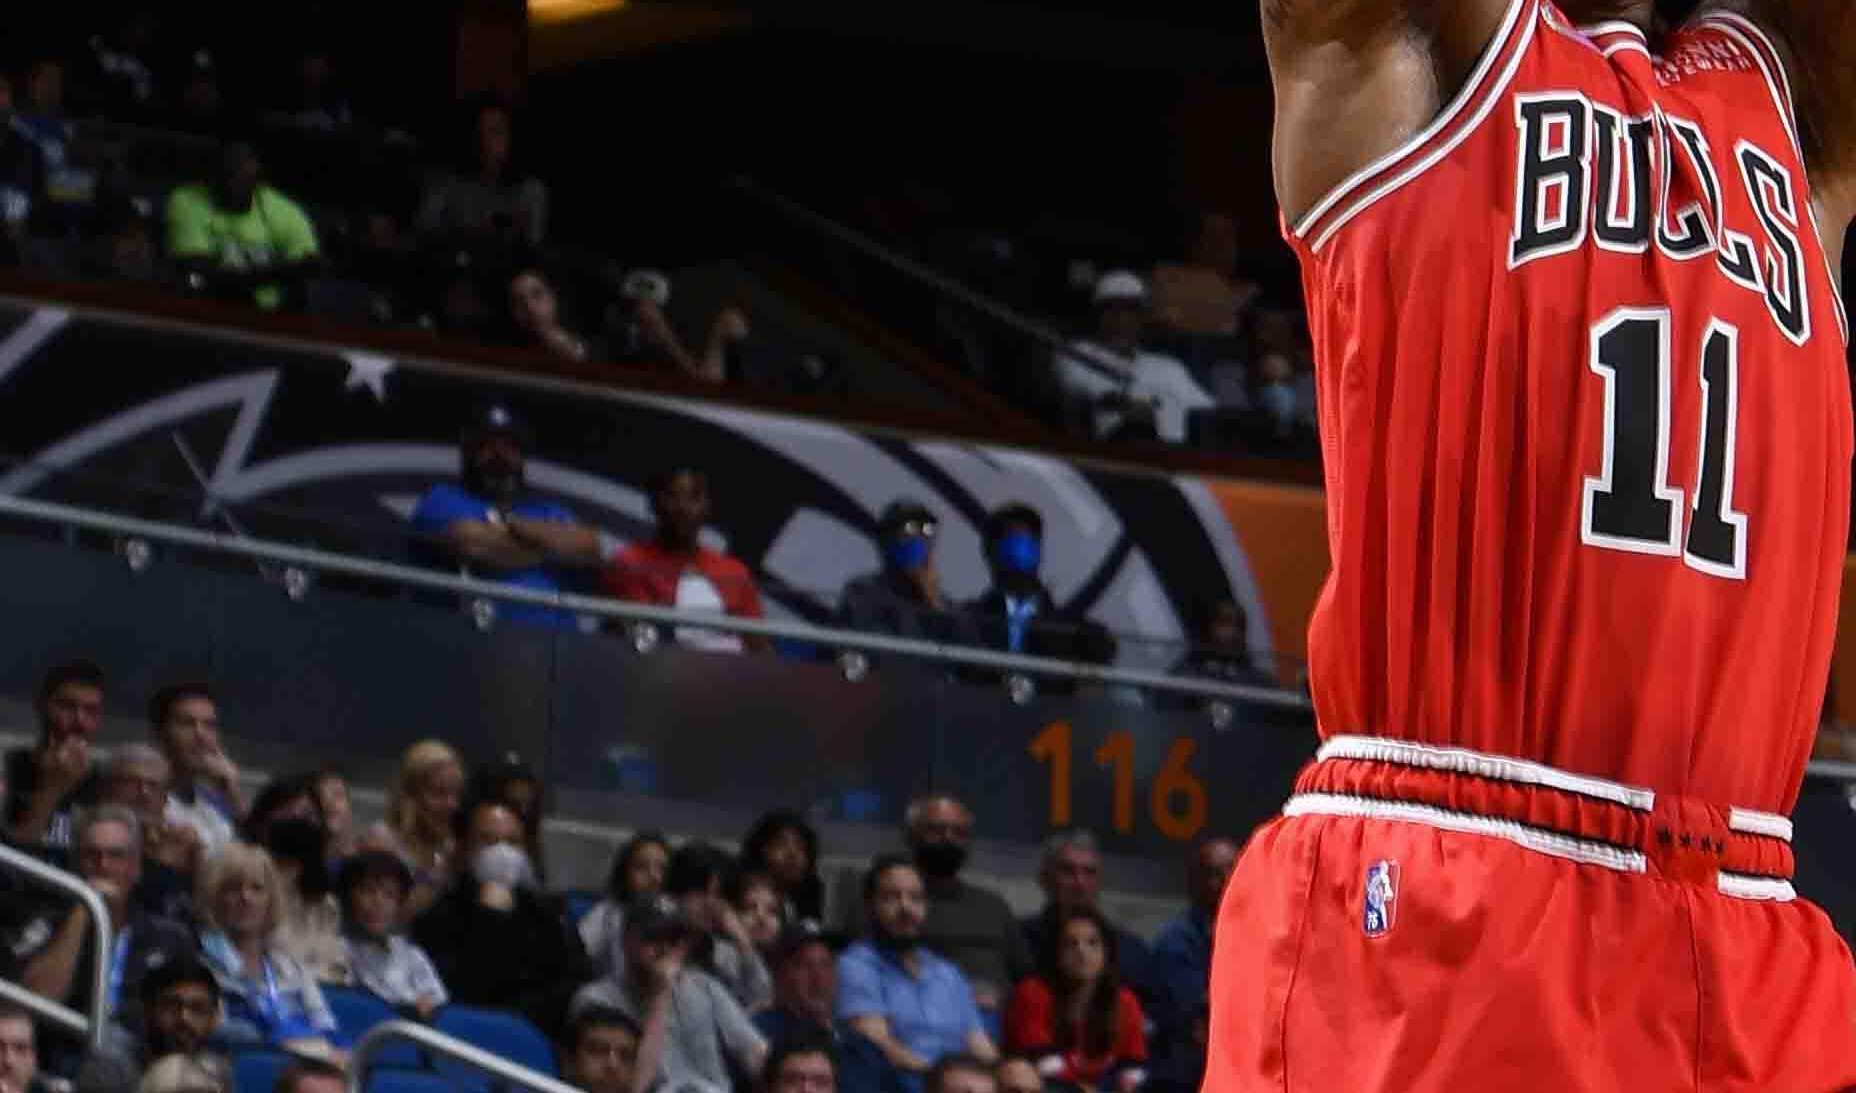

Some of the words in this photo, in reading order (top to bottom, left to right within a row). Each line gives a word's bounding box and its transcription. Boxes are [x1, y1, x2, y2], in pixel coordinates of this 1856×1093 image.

[1507, 91, 1811, 347] BULLS
[1581, 306, 1748, 581] 11
[1026, 719, 1210, 843] 116
